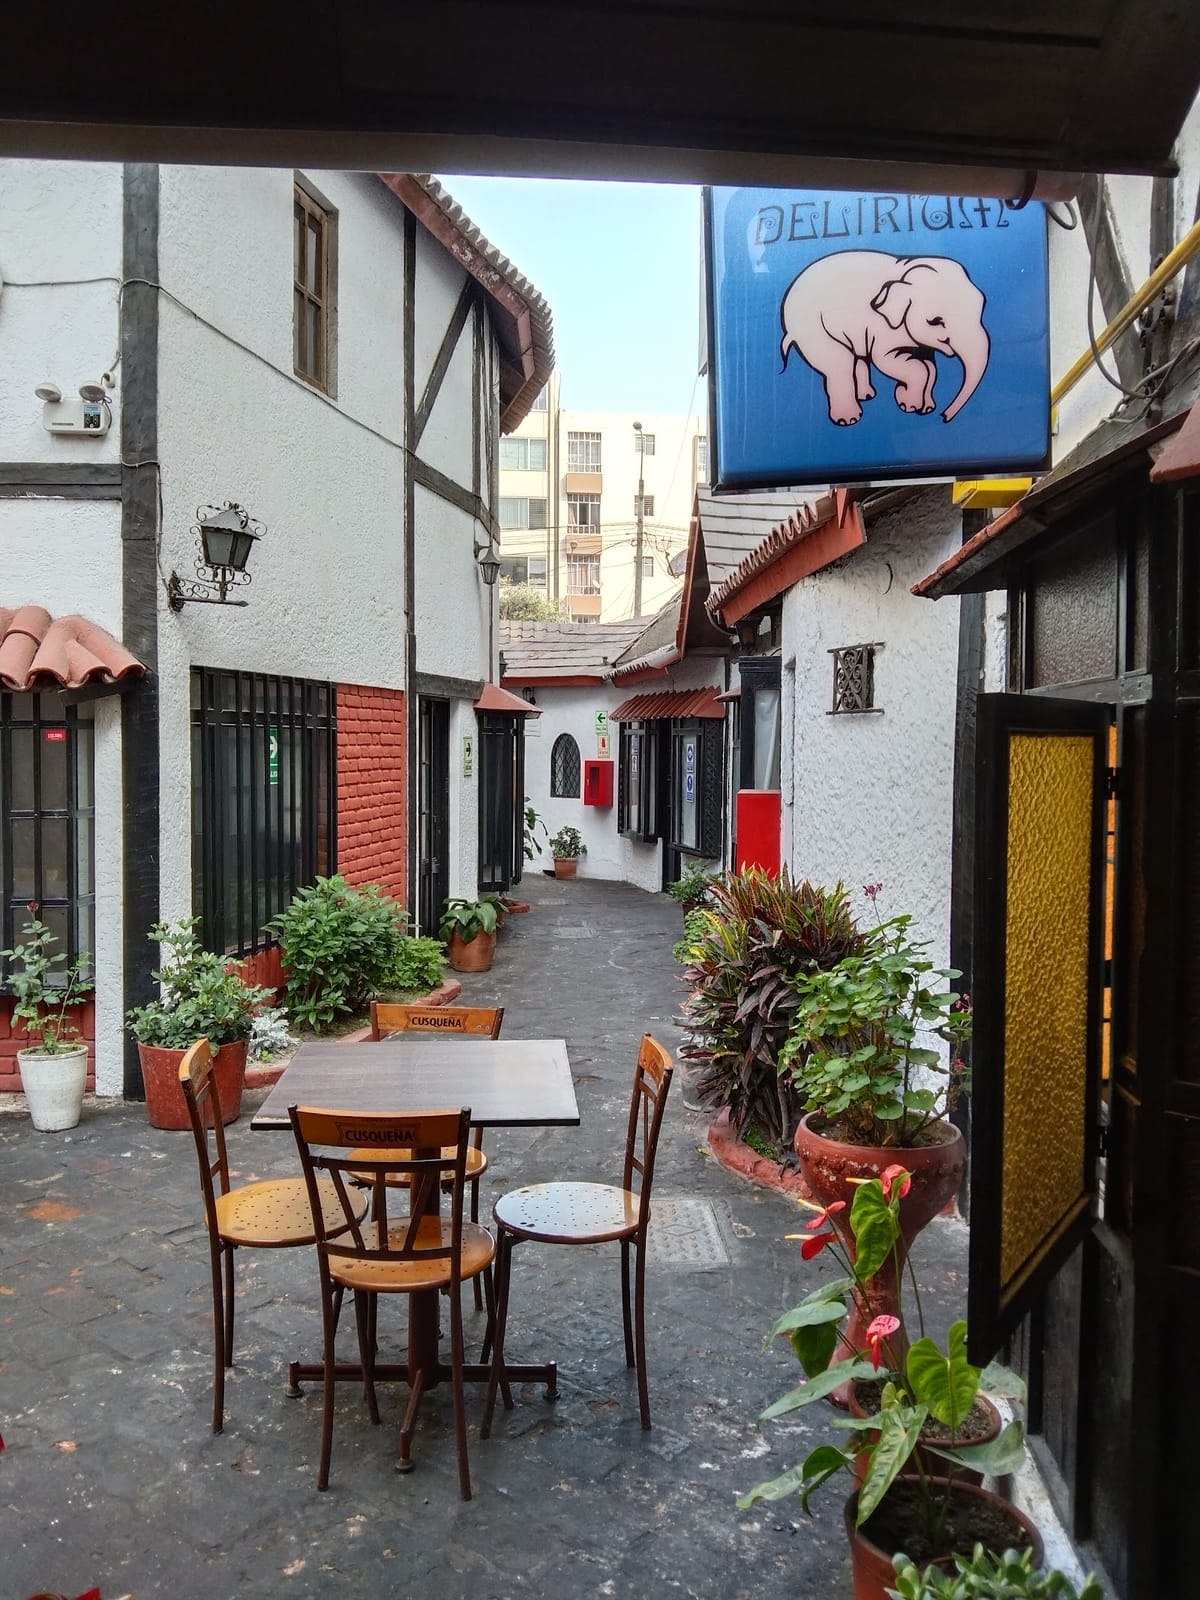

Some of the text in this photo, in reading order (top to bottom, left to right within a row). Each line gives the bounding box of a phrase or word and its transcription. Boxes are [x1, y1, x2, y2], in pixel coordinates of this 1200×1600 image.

[755, 195, 1010, 245] DELIRIUM
[411, 1016, 462, 1028] CUSQUEÑA
[345, 1128, 414, 1142] CUSQUEÑA
